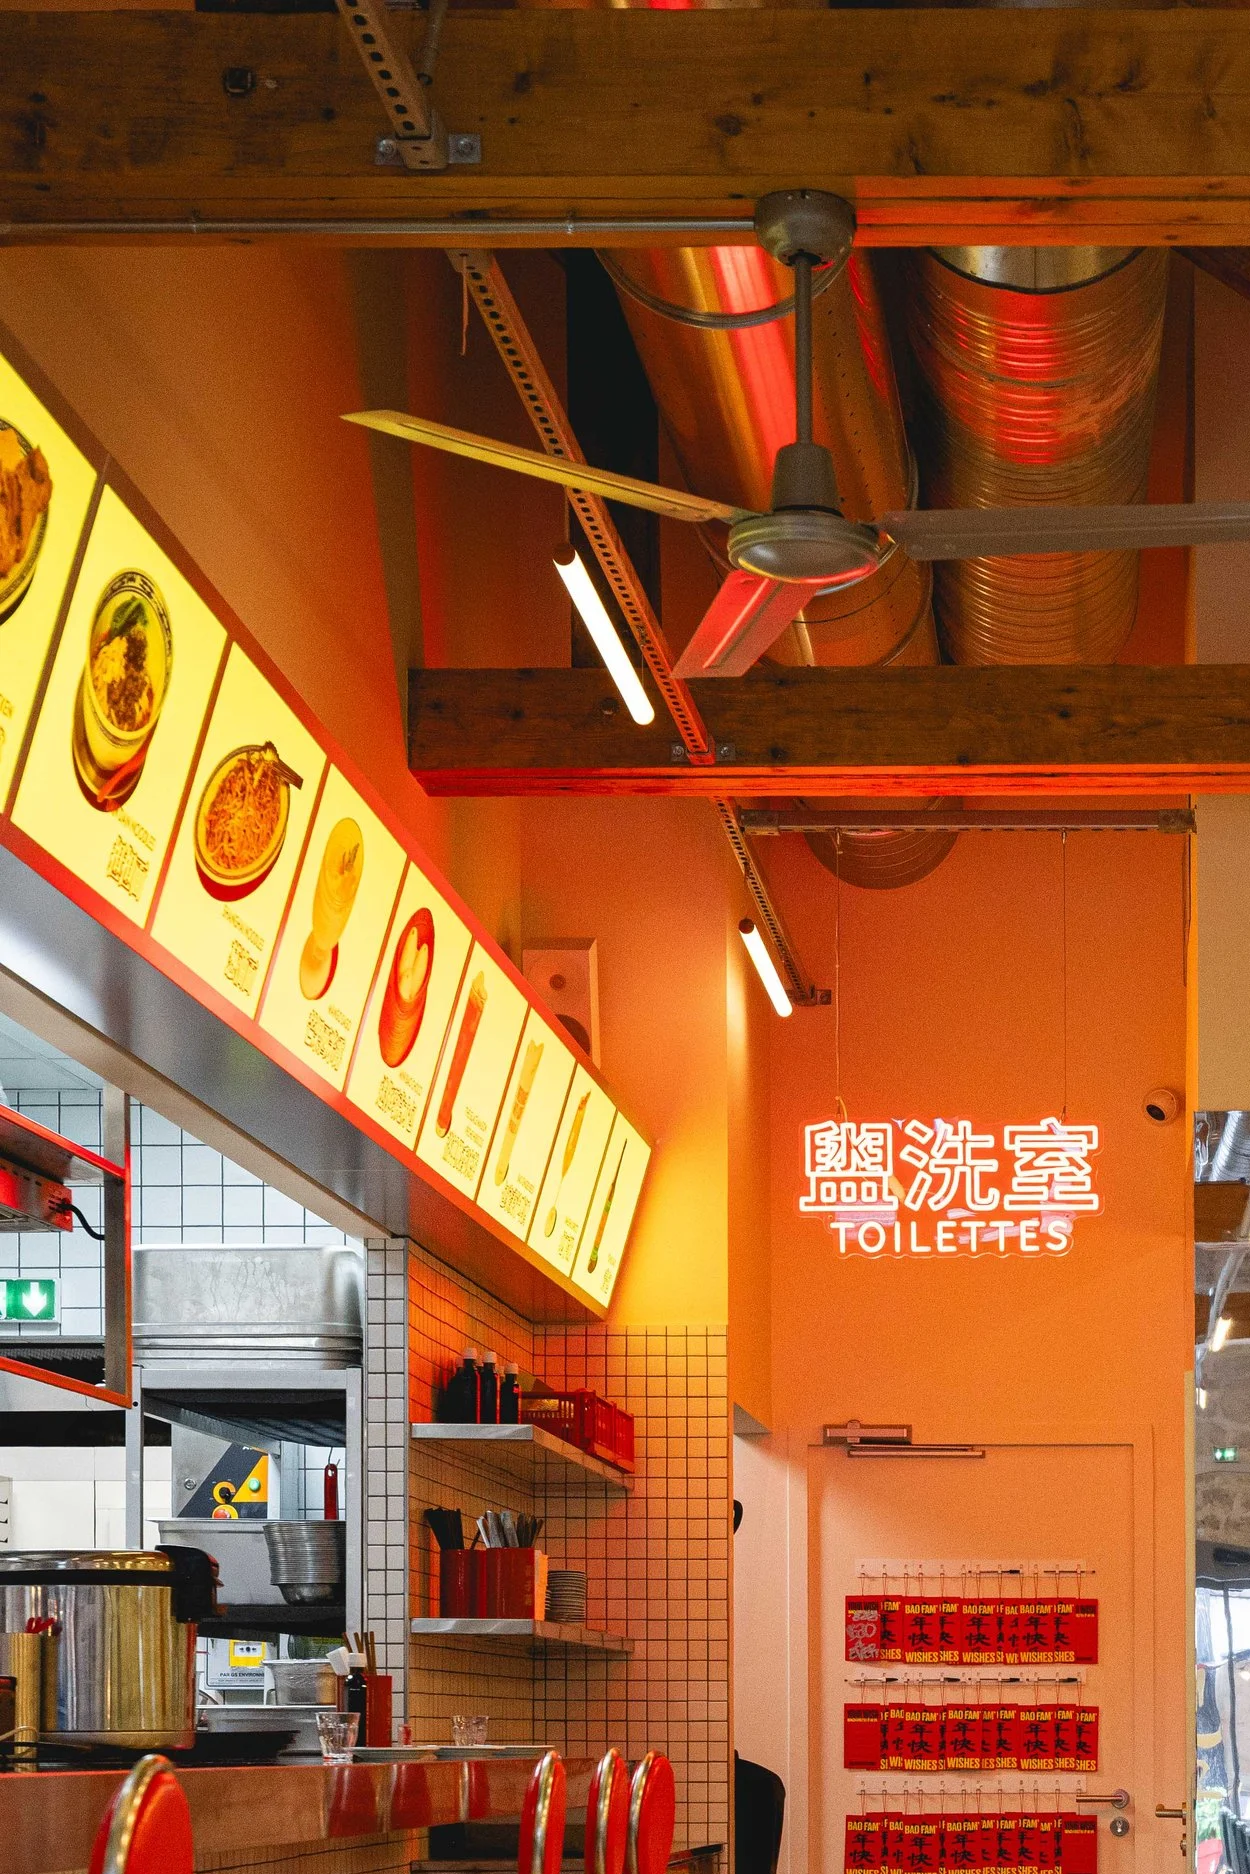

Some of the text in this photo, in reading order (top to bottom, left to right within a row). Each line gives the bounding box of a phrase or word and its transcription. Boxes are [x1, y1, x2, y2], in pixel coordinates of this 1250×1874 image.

[799, 1116, 1099, 1211] 盥洗室
[830, 1220, 1069, 1253] TOILETTES
[905, 1605, 920, 1614] BAO
[963, 1605, 977, 1614] BAO
[1020, 1605, 1035, 1614] BAO
[880, 1649, 901, 1660] SHES
[905, 1652, 938, 1663] WISHES
[940, 1651, 959, 1661] SHES
[963, 1652, 995, 1663] WISHES
[1020, 1651, 1053, 1663] WISHES
[1054, 1651, 1074, 1662] SHES
[906, 1712, 920, 1721] BAO
[948, 1710, 963, 1719] BAO
[1020, 1712, 1035, 1721] BAO
[904, 1759, 937, 1770] WISHES
[947, 1757, 980, 1768] WISHES
[996, 1758, 1017, 1769] SHES
[1020, 1759, 1053, 1769] WISHES
[1055, 1758, 1074, 1769] SHES
[1076, 1760, 1096, 1771] SHES
[848, 1822, 863, 1831] BAO
[905, 1825, 919, 1834] BAO
[947, 1822, 961, 1831] BAO
